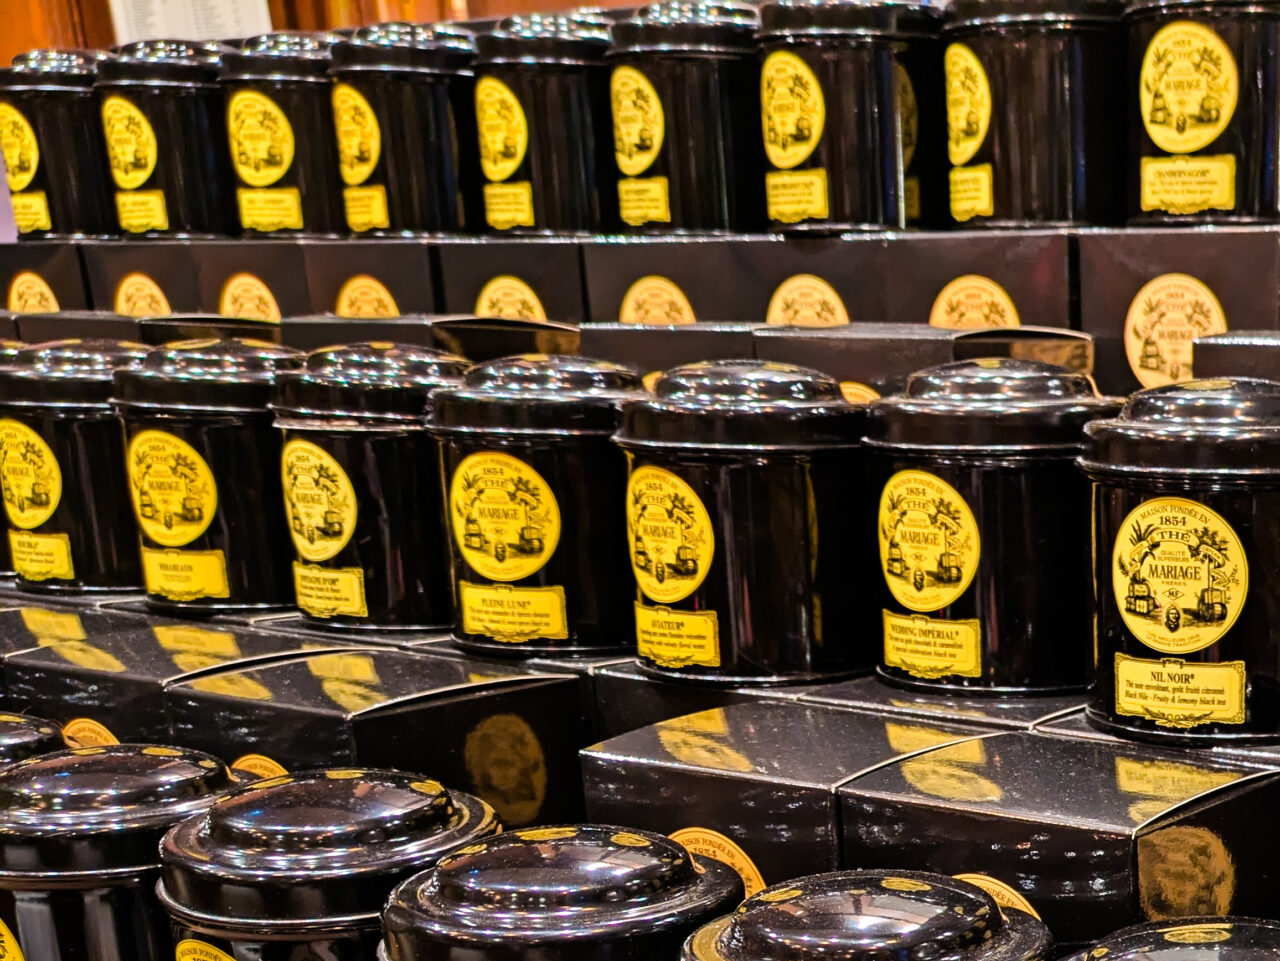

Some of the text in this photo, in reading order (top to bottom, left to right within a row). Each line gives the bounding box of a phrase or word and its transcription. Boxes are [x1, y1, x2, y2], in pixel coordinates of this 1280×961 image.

[478, 507, 519, 520] MARIAGE
[1159, 516, 1187, 527] 1854
[642, 524, 677, 540] MARIAGE
[900, 530, 940, 547] MARIAGE
[1148, 564, 1201, 581] MARIAGE
[891, 623, 917, 637] WEDDING
[1151, 671, 1166, 682] NIL
